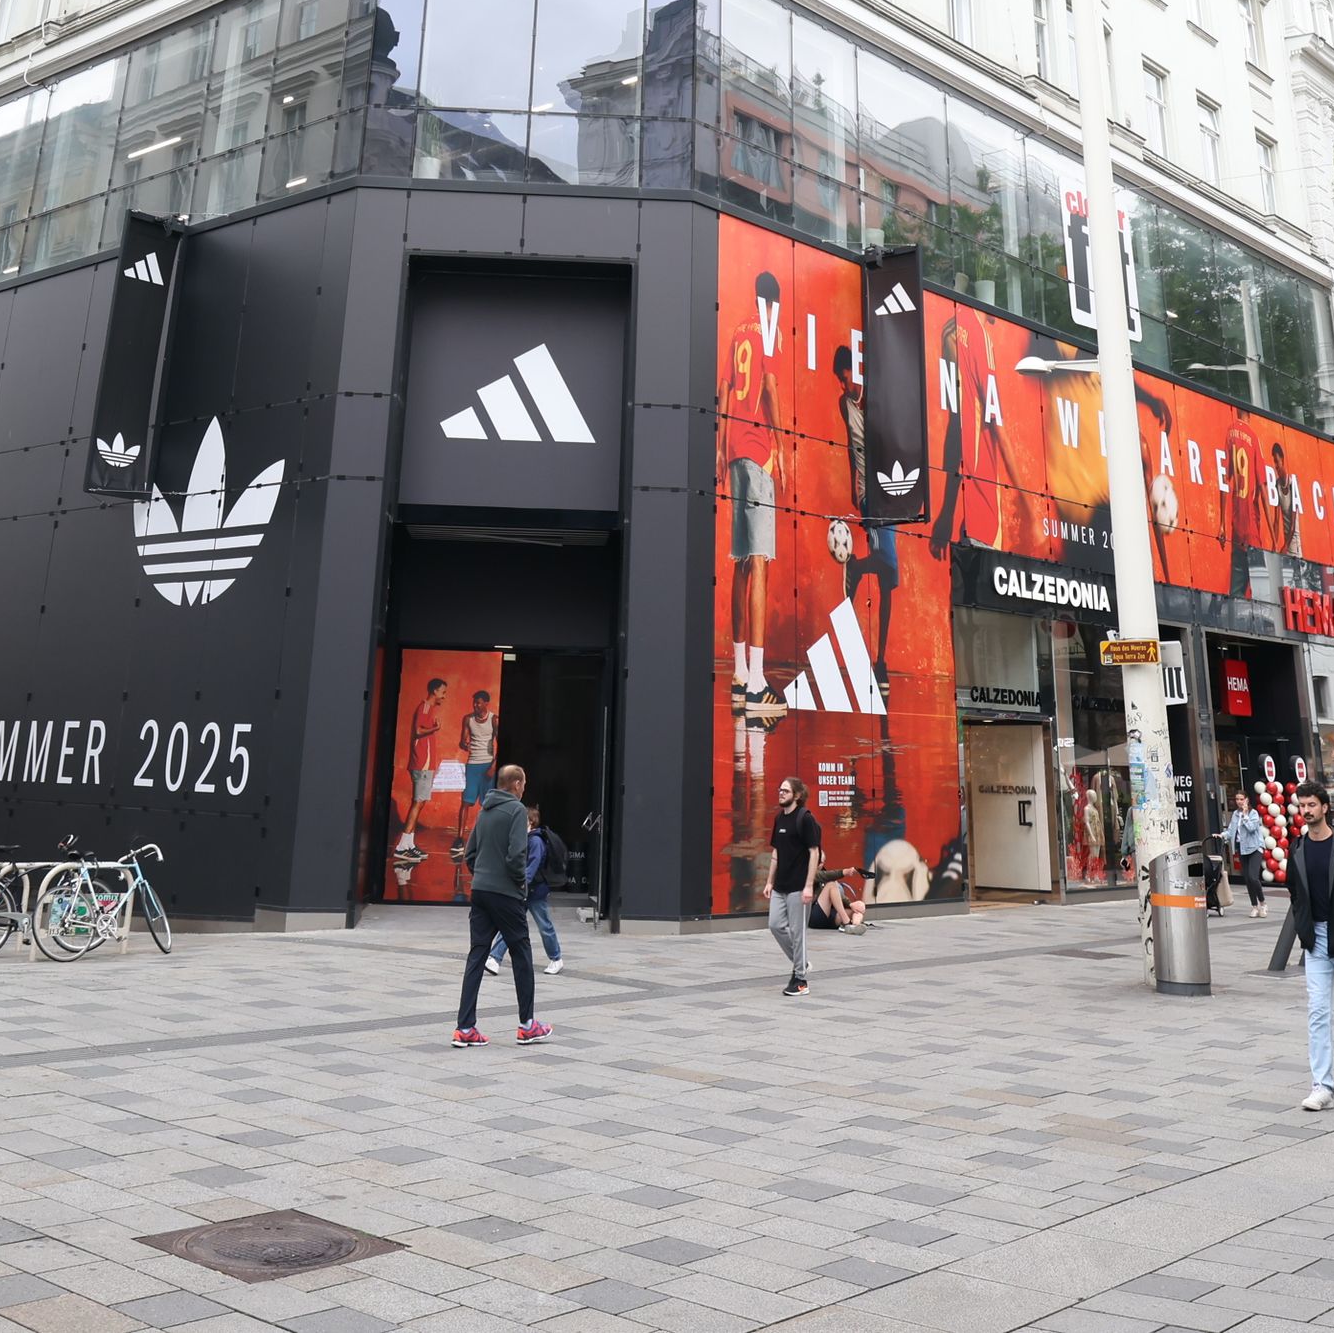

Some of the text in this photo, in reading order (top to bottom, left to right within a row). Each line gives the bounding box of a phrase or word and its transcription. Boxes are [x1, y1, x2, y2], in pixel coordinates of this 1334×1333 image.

[757, 296, 1003, 426] VIENA
[1159, 431, 1229, 493] ARE
[1042, 517, 1116, 551] SUMMER 20
[993, 566, 1111, 612] CALZEDONIA
[970, 686, 1042, 708] CALZEDONIA
[1227, 676, 1250, 692] HEMA
[133, 718, 253, 797] 2025
[818, 775, 856, 786] UNSER TEAM!
[979, 784, 1037, 795] CALZEDONIA
